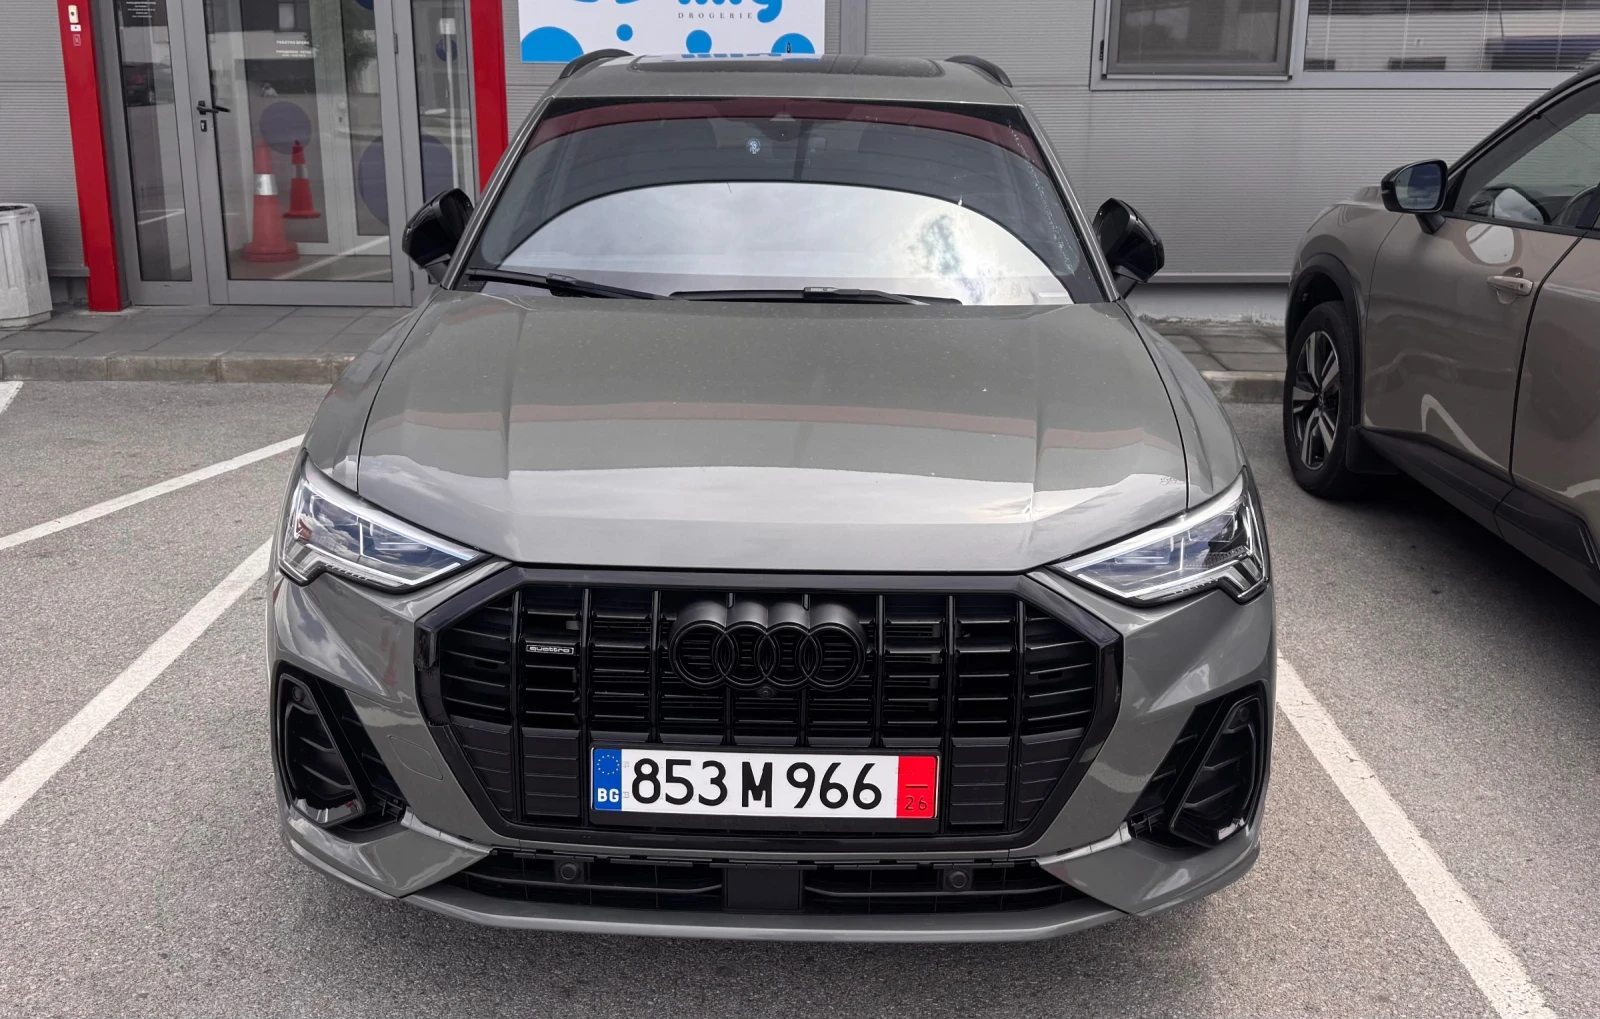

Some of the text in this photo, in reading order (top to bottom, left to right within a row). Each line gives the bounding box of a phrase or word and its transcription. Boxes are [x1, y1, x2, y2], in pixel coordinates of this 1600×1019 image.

[677, 12, 753, 20] DROGERIE
[631, 758, 882, 810] 853 M 966
[597, 787, 620, 803] BG
[904, 795, 929, 811] 26
